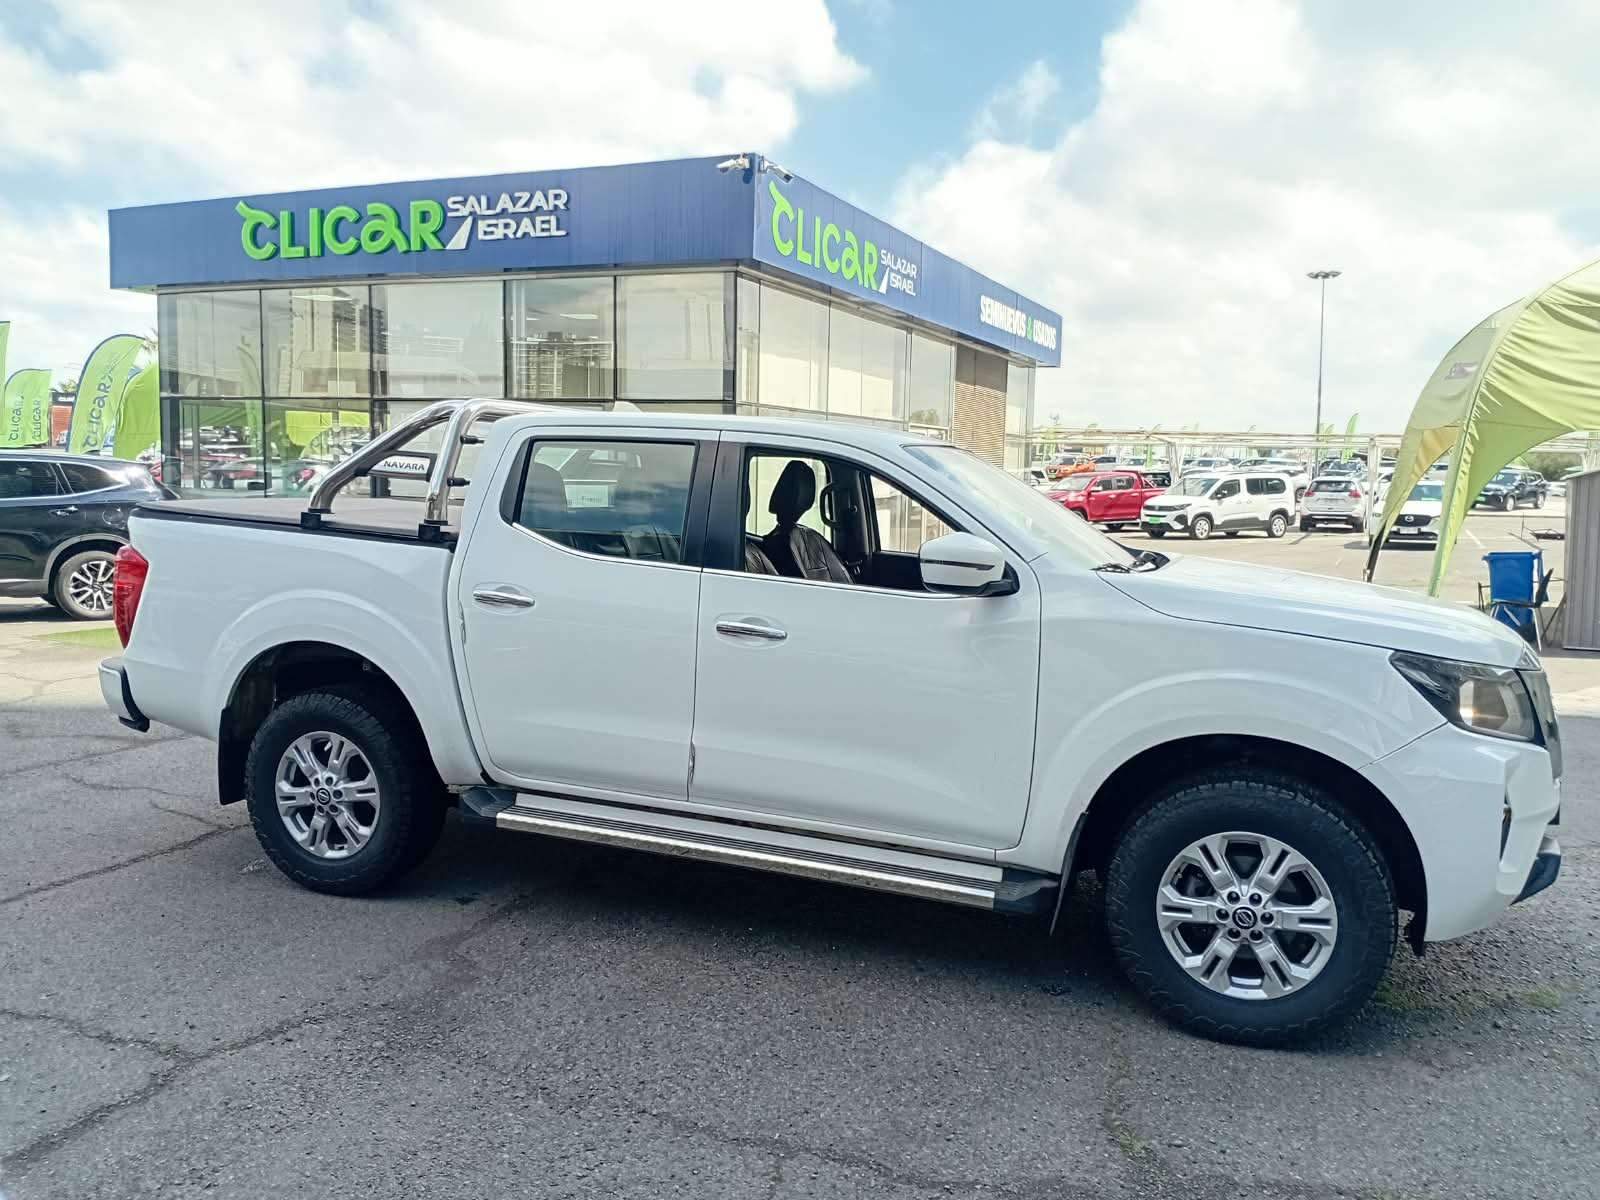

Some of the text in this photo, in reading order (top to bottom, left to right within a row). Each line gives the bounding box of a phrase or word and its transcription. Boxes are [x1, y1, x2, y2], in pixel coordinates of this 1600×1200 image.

[447, 188, 568, 217] SALAZAR
[477, 214, 568, 241] ISRAEL
[880, 249, 917, 279] SALAZAR
[890, 273, 916, 296] ISRAEL
[384, 460, 425, 471] NAVARA
